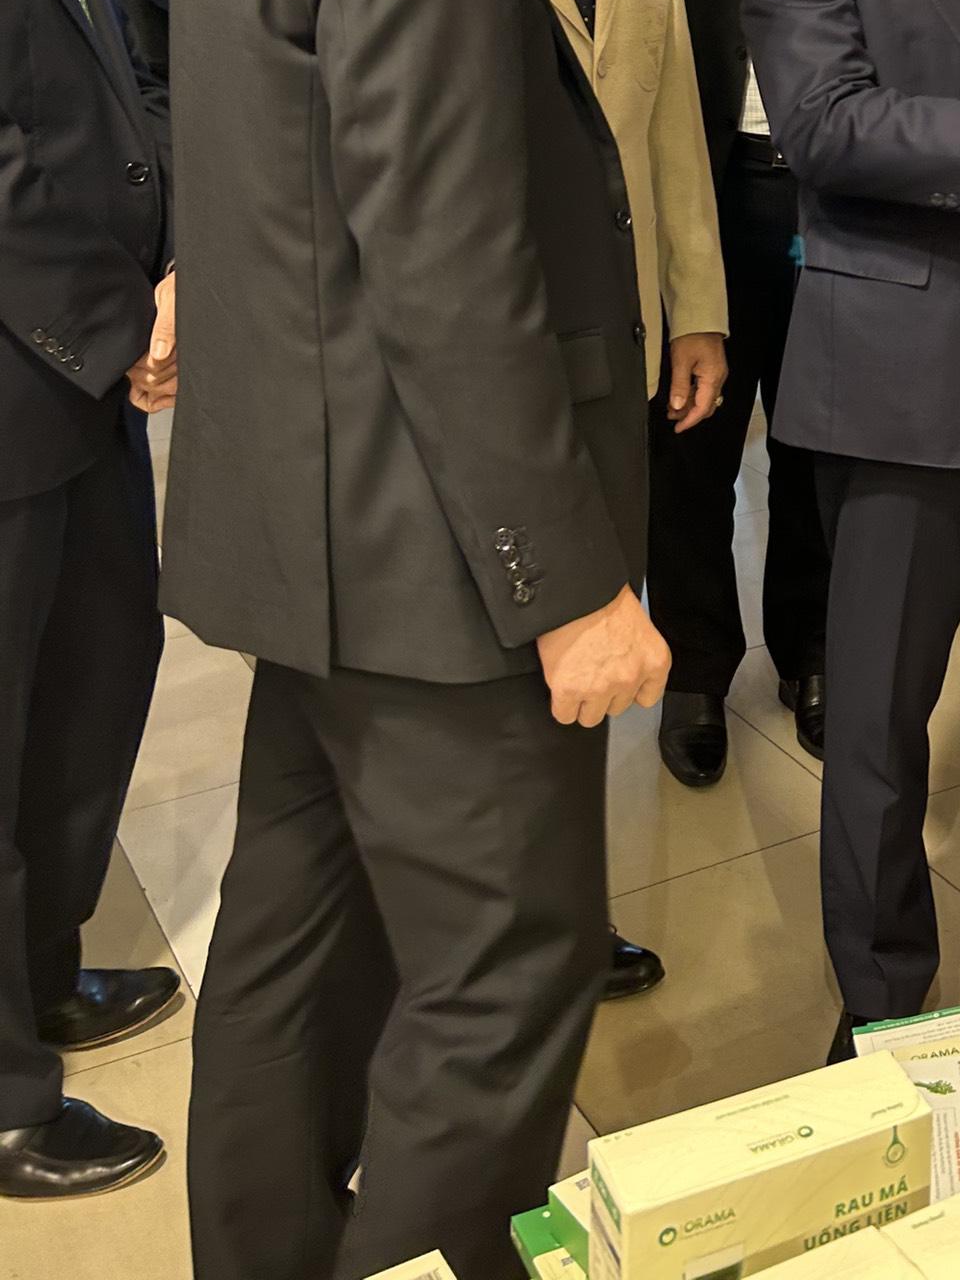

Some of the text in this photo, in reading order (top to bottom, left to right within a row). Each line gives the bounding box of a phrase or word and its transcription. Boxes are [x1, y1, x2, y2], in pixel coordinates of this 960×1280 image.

[834, 1174, 909, 1218] RAU MÁ
[684, 1207, 737, 1232] ORAMA
[804, 1220, 860, 1251] UỐNG
